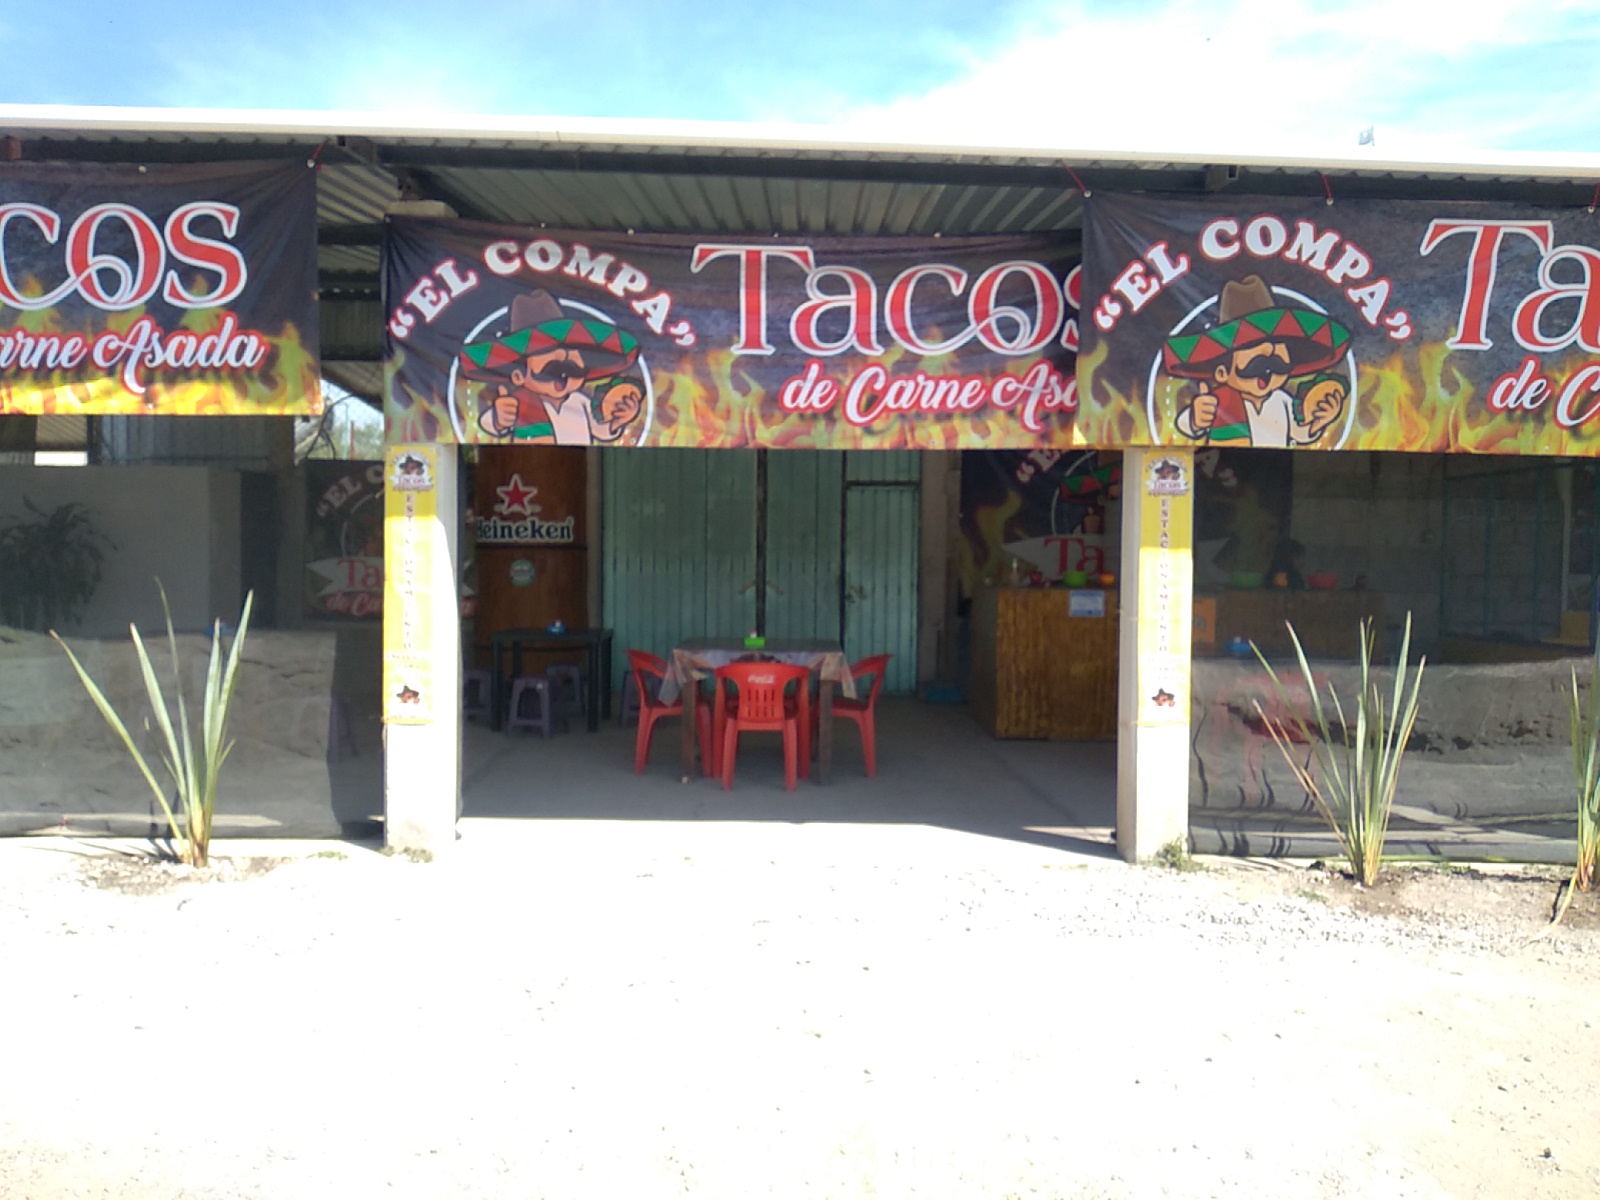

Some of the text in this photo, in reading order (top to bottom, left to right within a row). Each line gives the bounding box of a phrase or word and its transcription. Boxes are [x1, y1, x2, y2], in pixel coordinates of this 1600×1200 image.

[691, 243, 1081, 356] Taco
[92, 314, 266, 394] Asada
[1490, 357, 1552, 411] de
[781, 360, 838, 409] de
[843, 363, 987, 427] Carne
